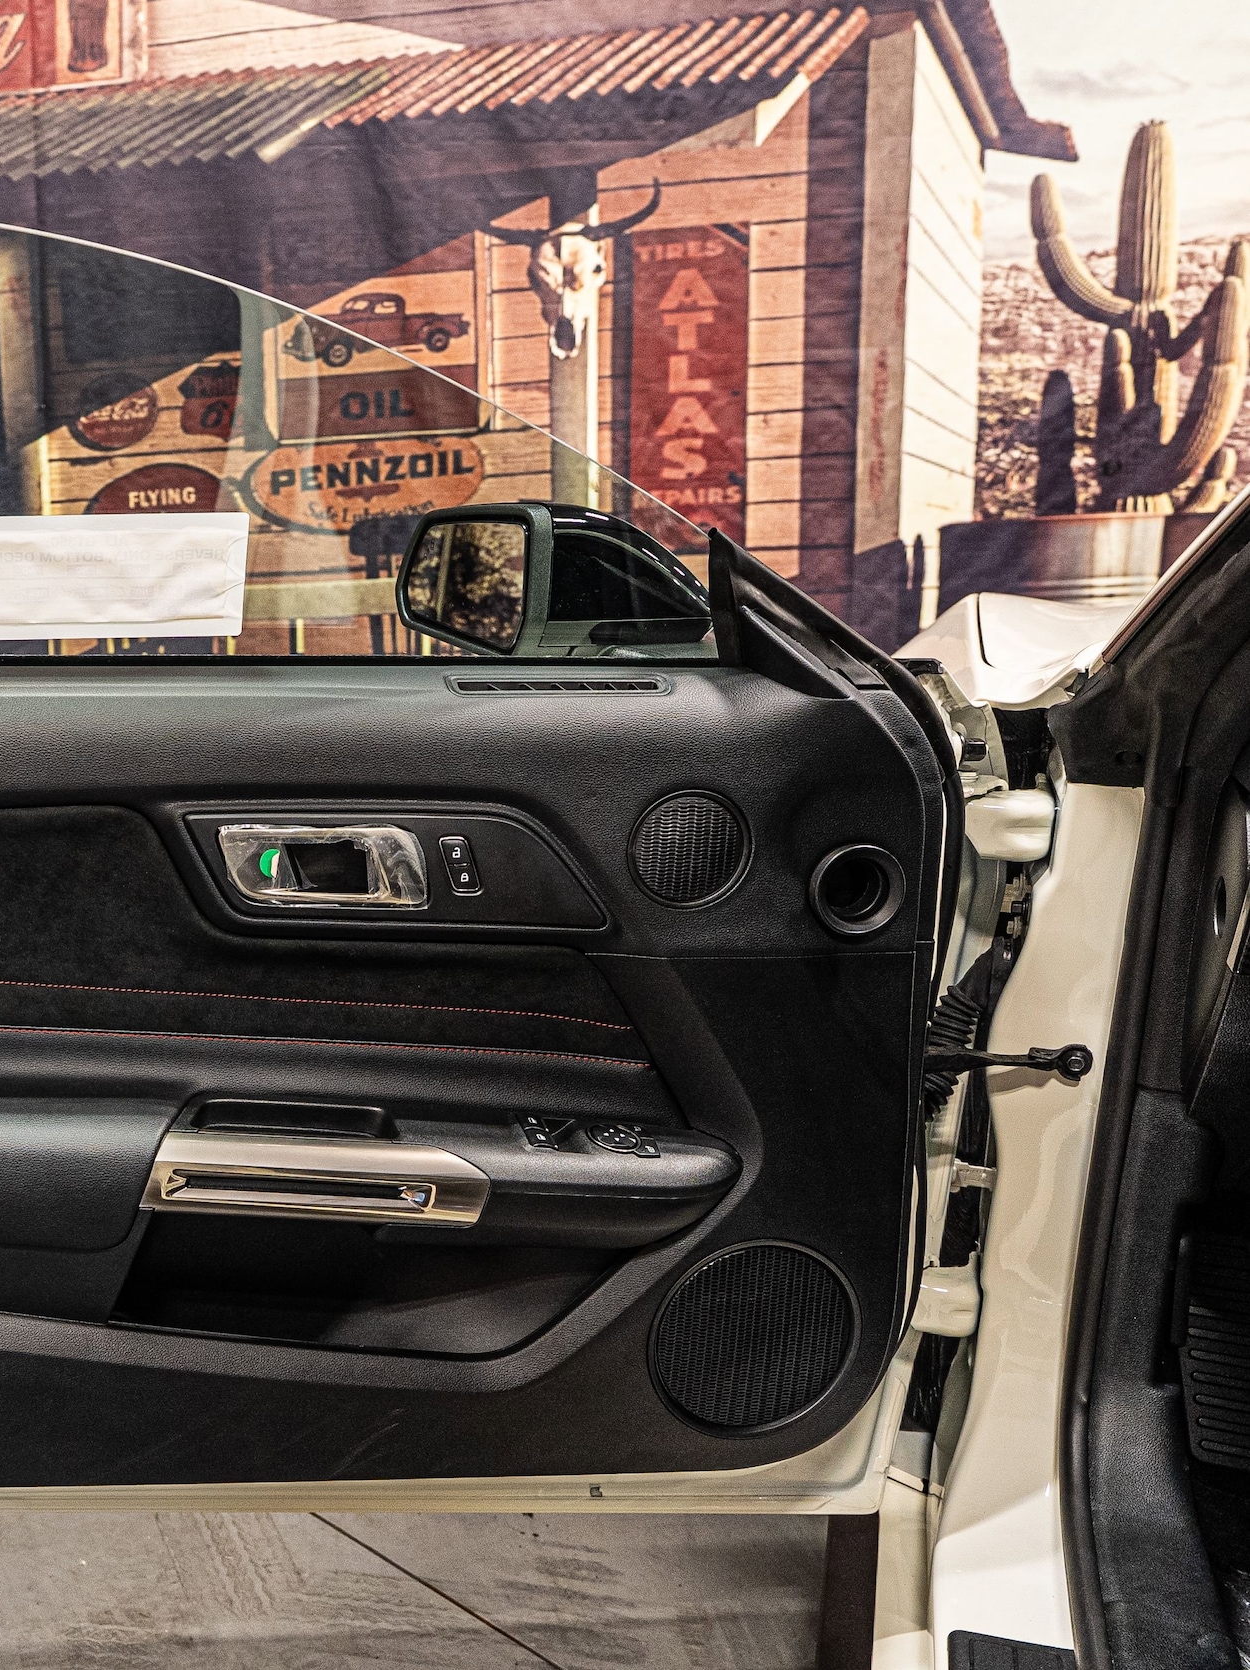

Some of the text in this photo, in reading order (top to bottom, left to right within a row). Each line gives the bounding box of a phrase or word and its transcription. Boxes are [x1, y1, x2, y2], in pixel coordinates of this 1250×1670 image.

[656, 268, 721, 480] ATLAS
[339, 389, 415, 421] OIL
[270, 449, 475, 495] PENNZOIL
[128, 485, 197, 510] FLYING
